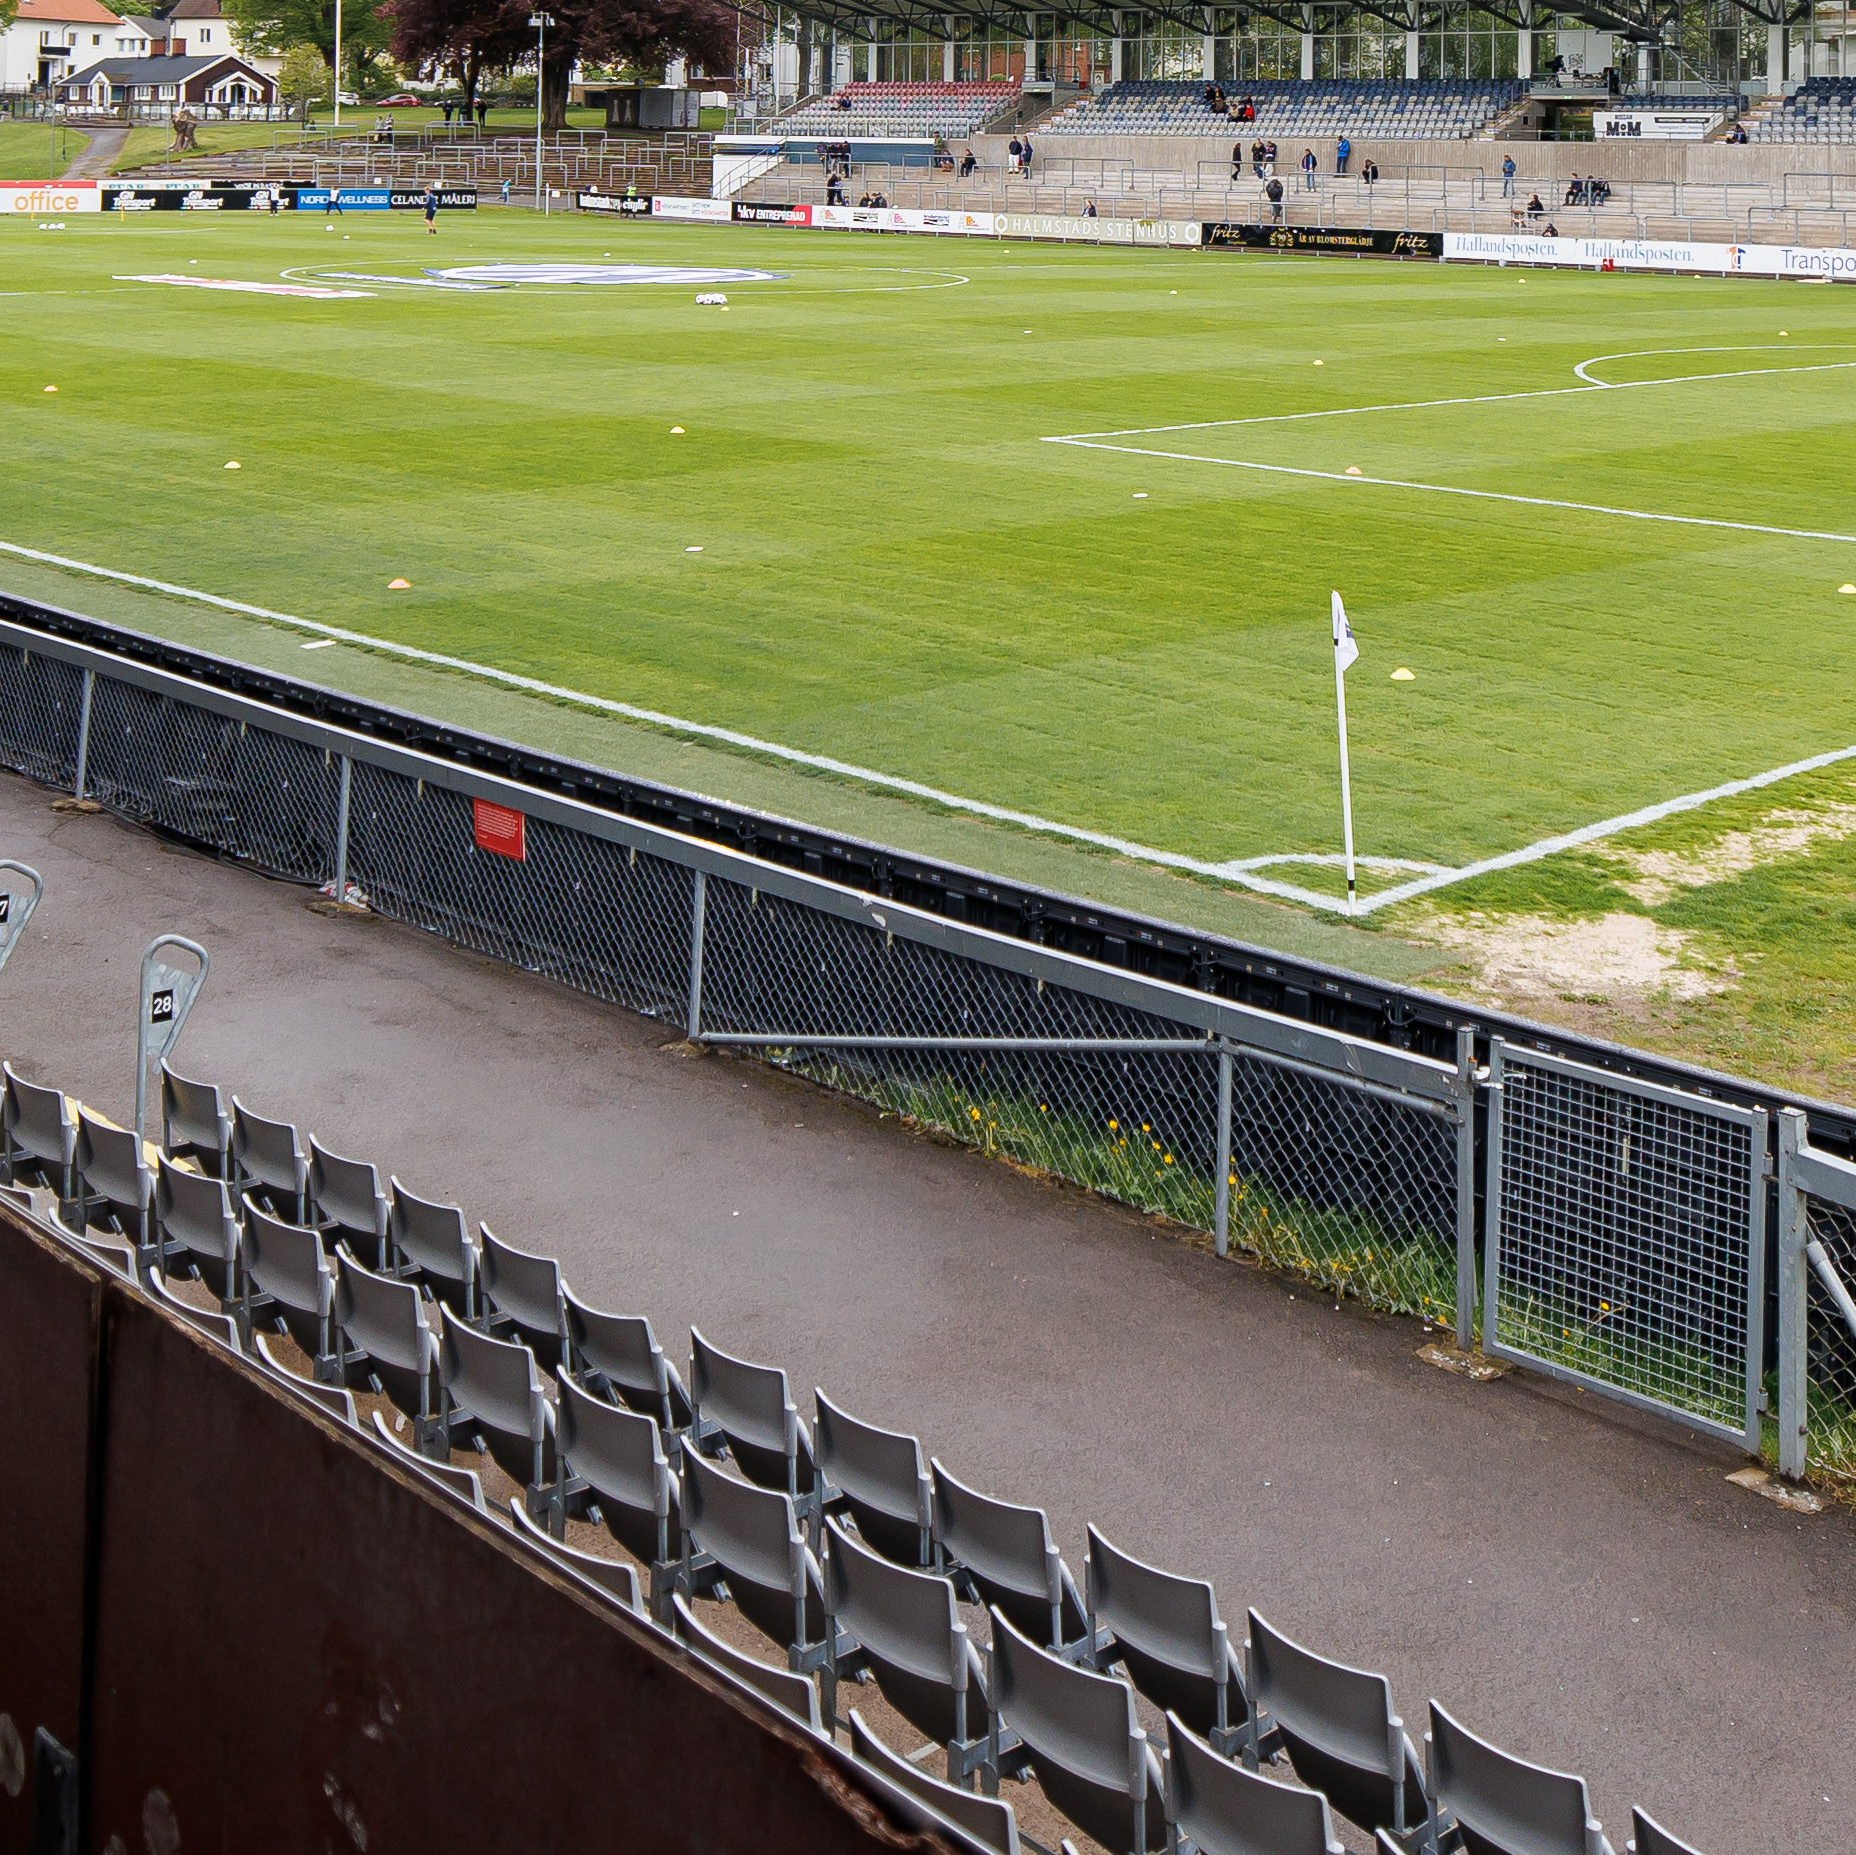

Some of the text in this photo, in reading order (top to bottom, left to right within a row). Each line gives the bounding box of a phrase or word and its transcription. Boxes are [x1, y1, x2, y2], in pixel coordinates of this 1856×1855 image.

[14, 191, 80, 211] office
[337, 195, 388, 204] WELLNESS
[441, 193, 475, 204] MÅLERI
[1013, 218, 1100, 236] HALMSTADS
[1209, 224, 1240, 244] fritz
[1392, 233, 1428, 254] fritz
[1455, 236, 1559, 258] Hallandsposten.
[1585, 242, 1695, 265] Hallandsposten.
[153, 996, 172, 1015] 28
